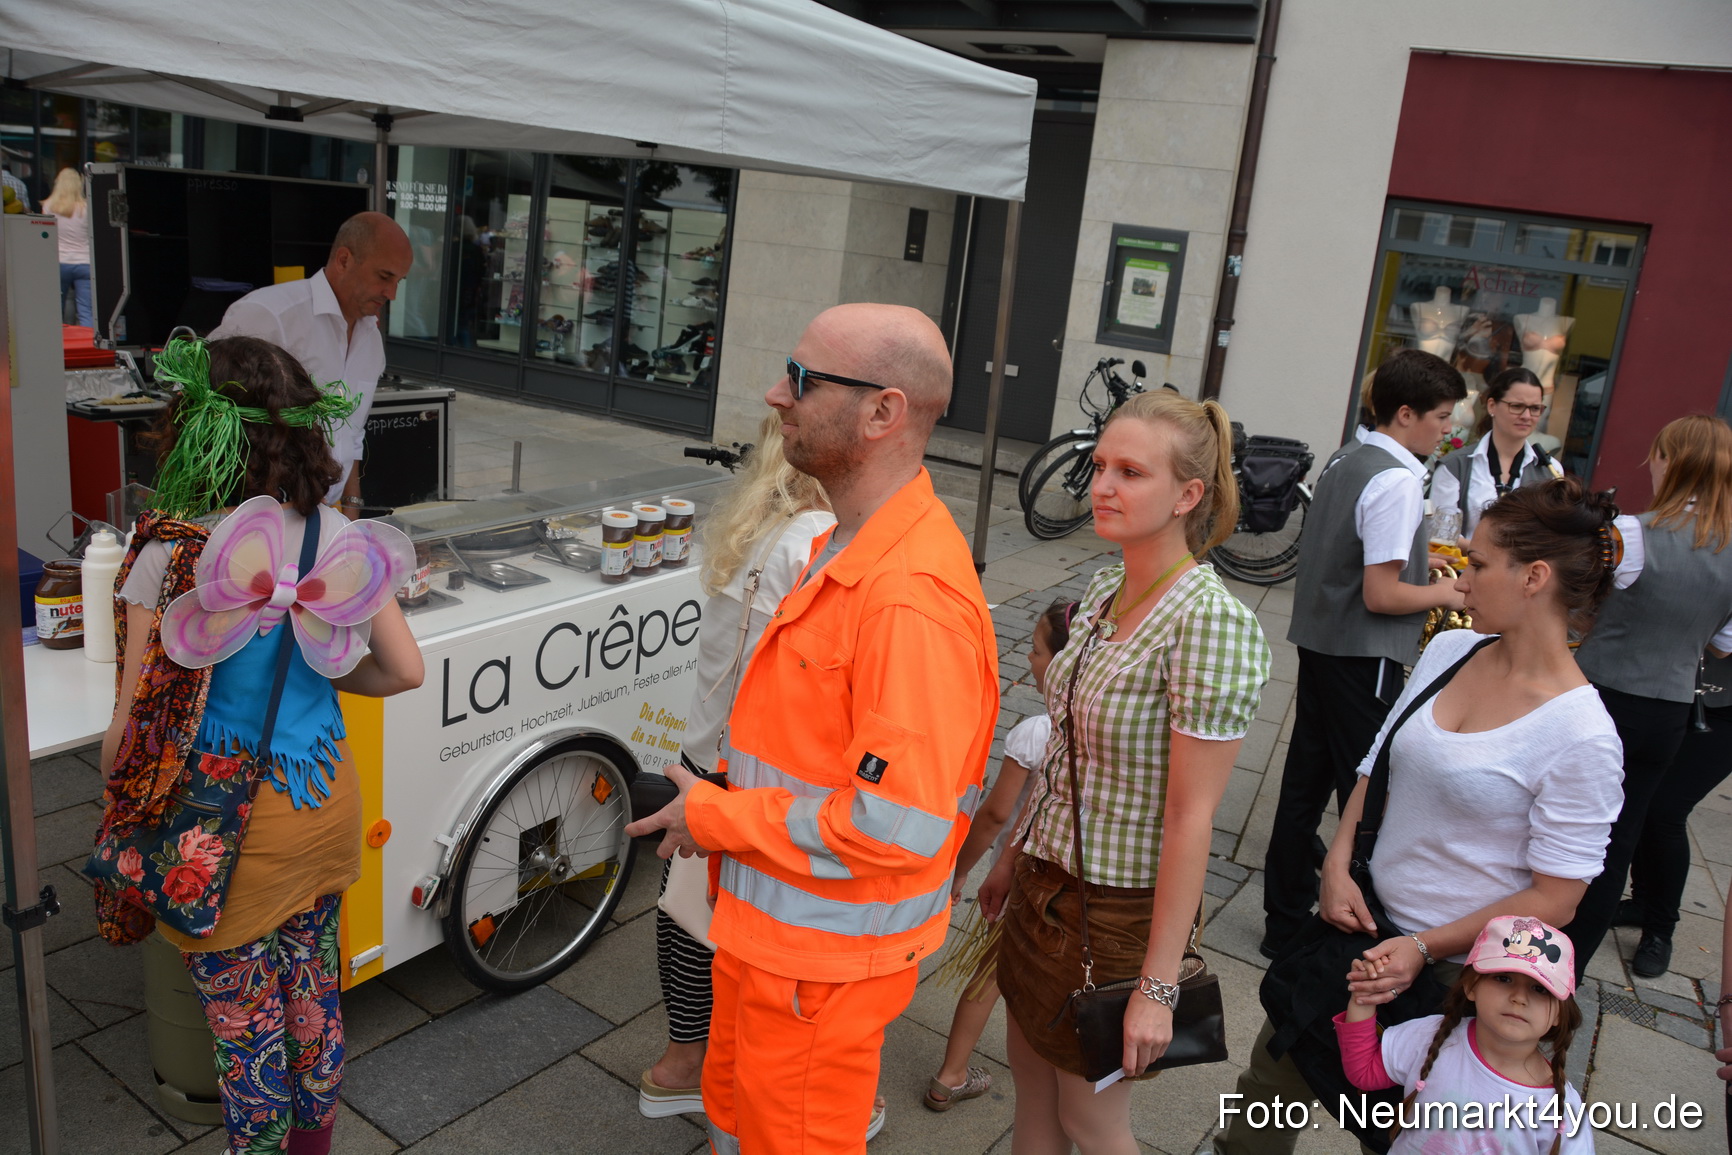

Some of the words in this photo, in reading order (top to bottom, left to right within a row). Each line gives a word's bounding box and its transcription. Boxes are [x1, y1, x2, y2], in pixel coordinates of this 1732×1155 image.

[1459, 266, 1540, 298] Achatz
[50, 604, 83, 617] nute
[442, 656, 511, 728] La
[535, 599, 702, 690] Crêpe
[439, 726, 516, 762] Geburtstag,
[521, 703, 574, 733] Hochzeit,
[577, 685, 631, 712] Jubiläum,
[633, 672, 660, 691] Feste
[662, 664, 683, 681] aller
[684, 657, 698, 673] Art
[639, 702, 655, 721] Die
[631, 725, 645, 743] die
[646, 734, 657, 747] zu
[658, 732, 681, 753] Ihnen
